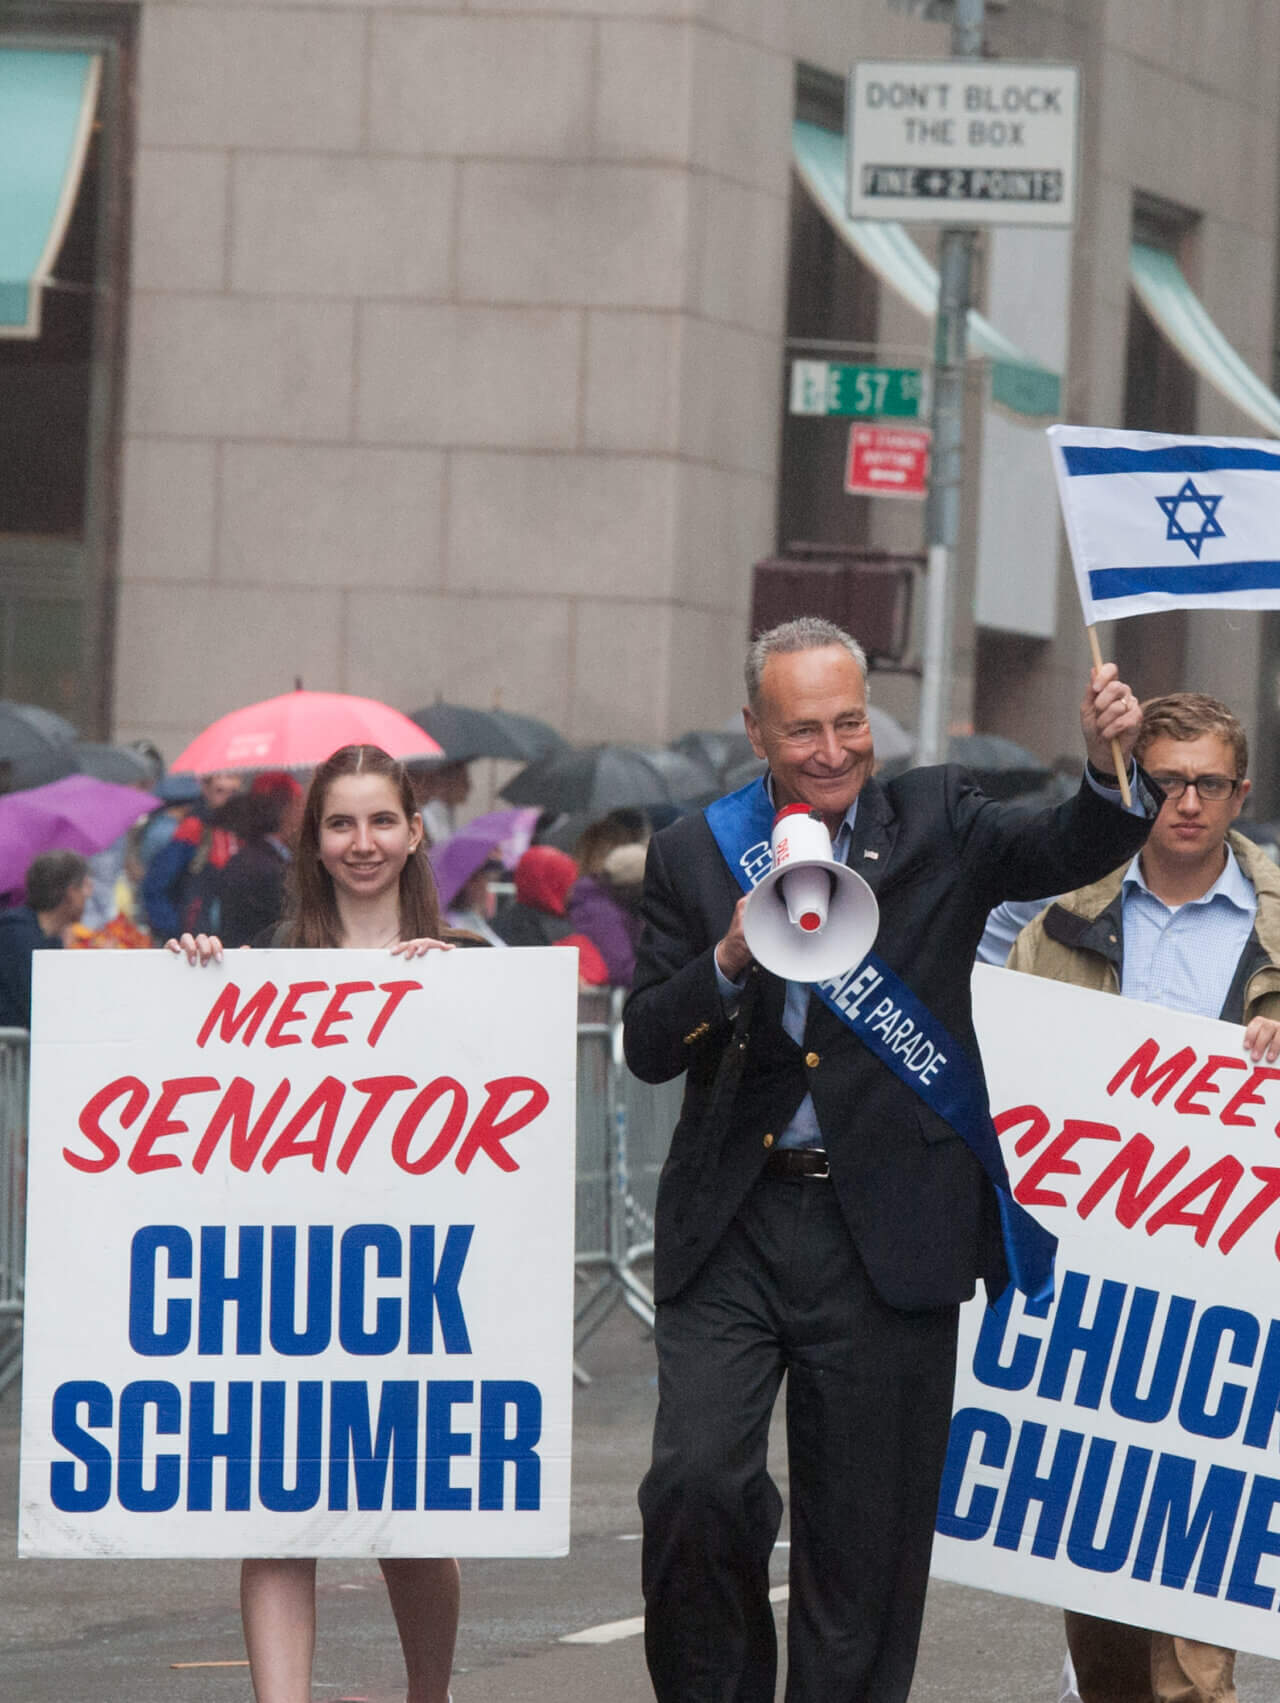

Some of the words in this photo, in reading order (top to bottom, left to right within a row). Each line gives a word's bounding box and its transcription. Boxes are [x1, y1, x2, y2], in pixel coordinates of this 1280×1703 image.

[866, 80, 949, 109] DON'T
[964, 83, 1062, 114] BLOCK
[904, 117, 956, 146] THE
[967, 120, 1025, 147] BOX
[864, 166, 918, 198] FINE
[971, 169, 1063, 202] POINTS
[856, 371, 890, 412] 57
[196, 980, 424, 1049] MEET
[863, 996, 948, 1086] PARADE
[62, 1075, 550, 1175] SENATOR
[128, 1223, 475, 1356] CHUCK
[50, 1379, 543, 1512] SCHUMER
